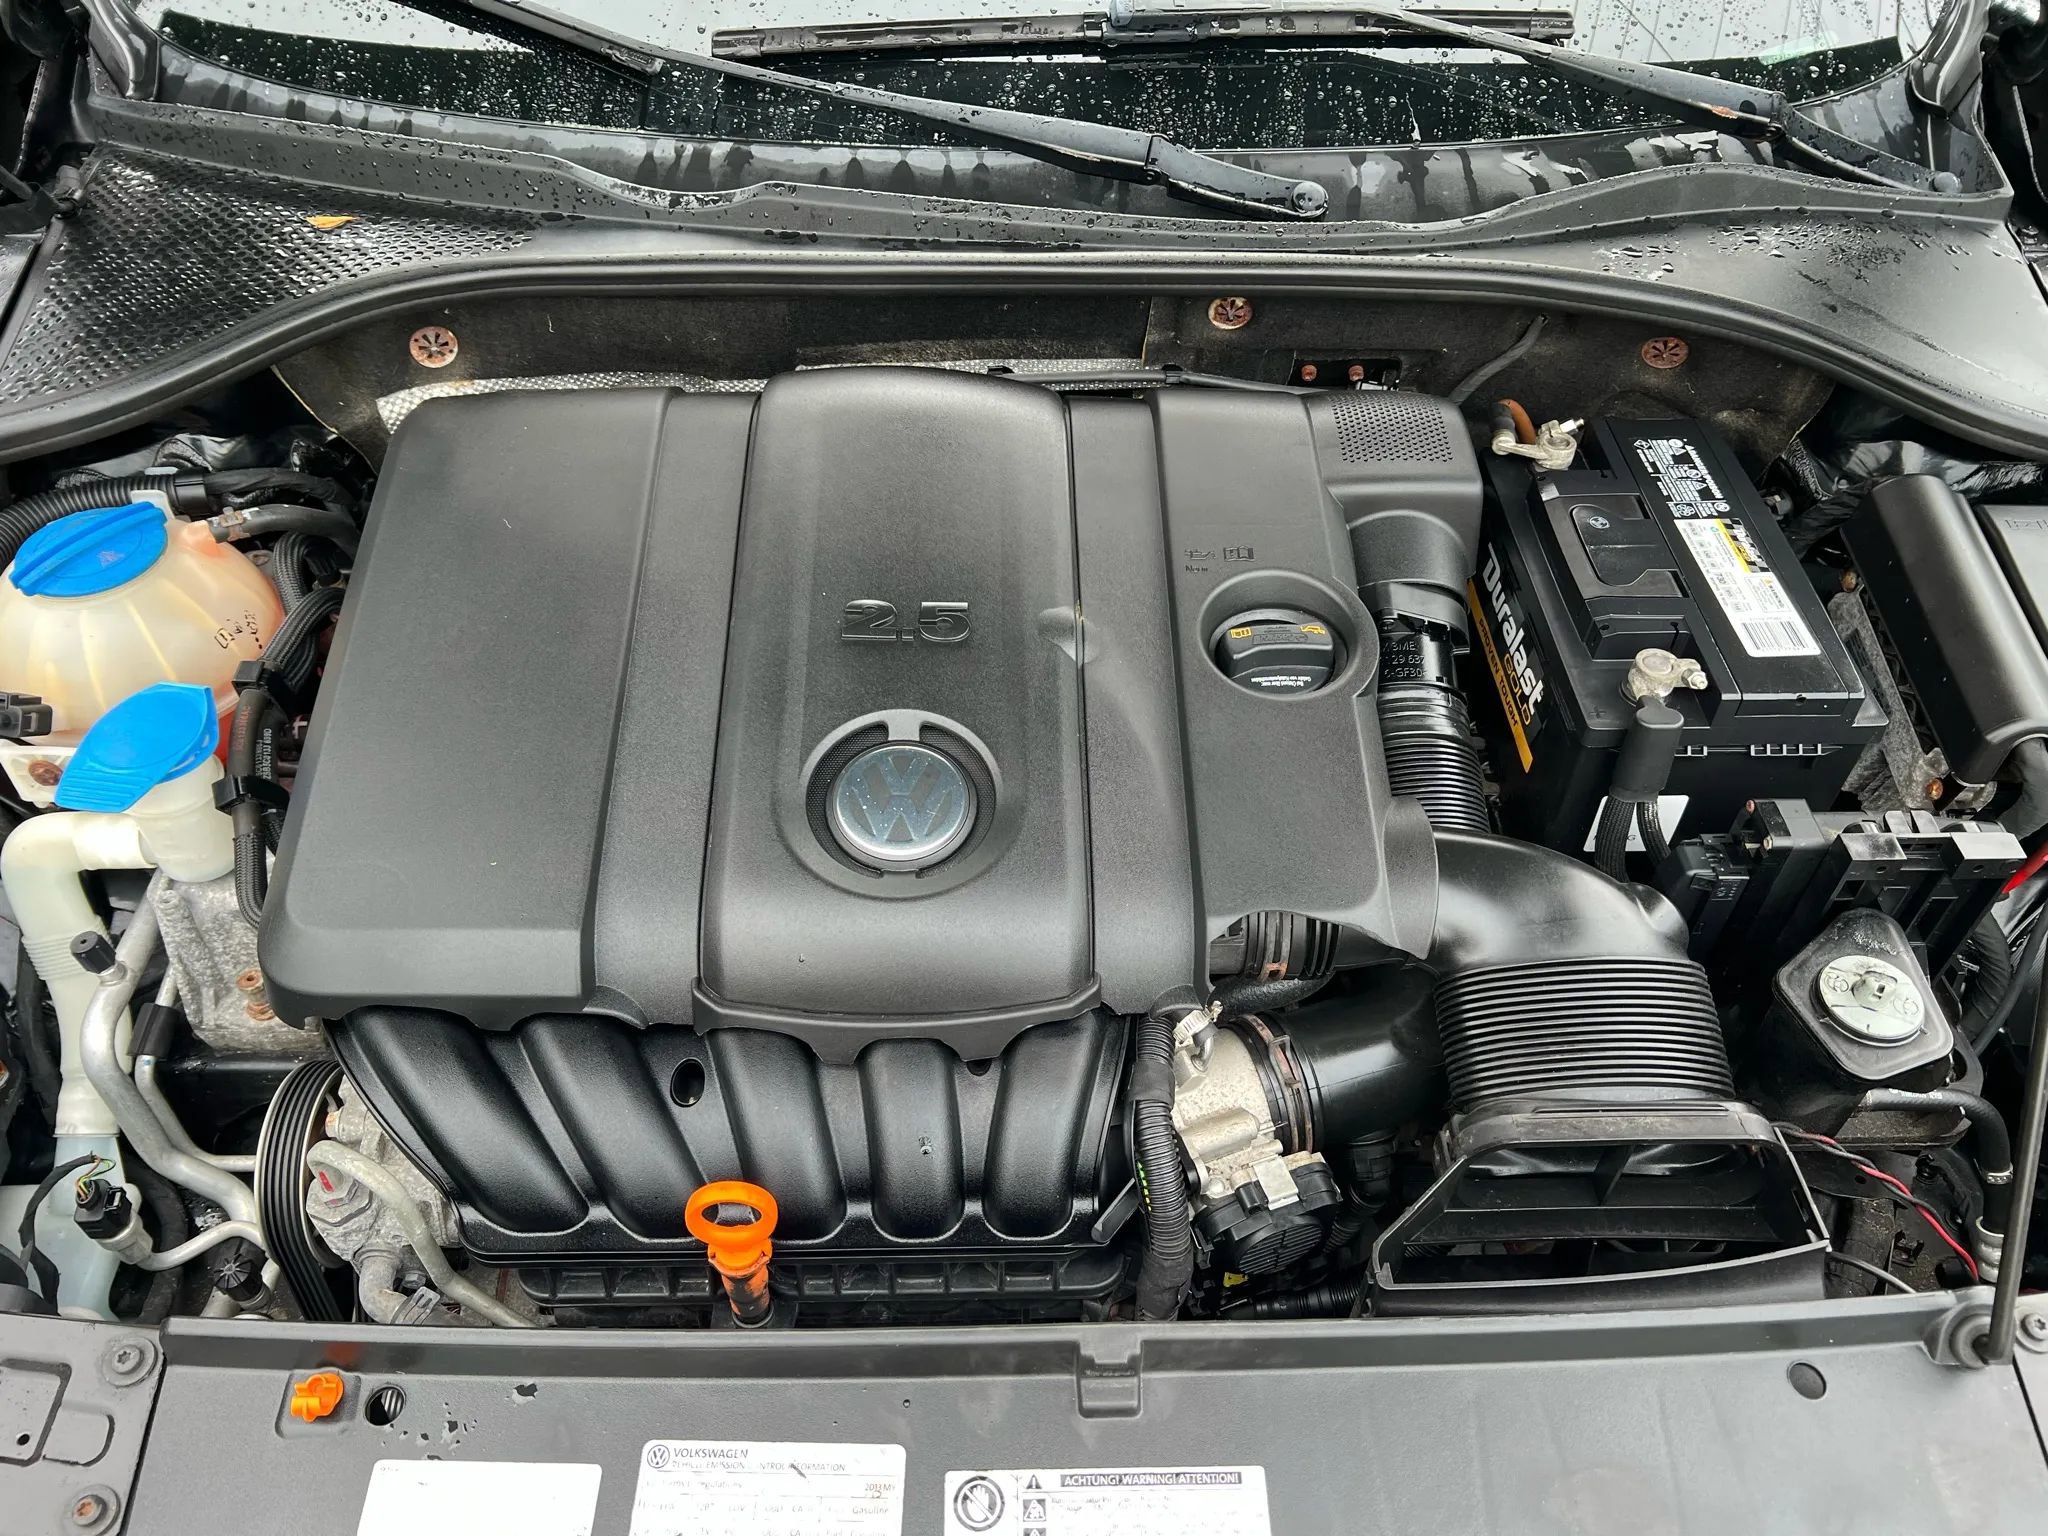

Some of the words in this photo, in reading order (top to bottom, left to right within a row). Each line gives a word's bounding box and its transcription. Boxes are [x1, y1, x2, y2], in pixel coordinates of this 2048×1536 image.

[841, 599, 972, 642] 2.5
[1482, 542, 1544, 716] Duralast
[1478, 618, 1500, 674] PROVEN
[1499, 678, 1518, 727] TOUGH
[1504, 653, 1531, 726] GOLD
[673, 1448, 749, 1459] VOLKSWAGEN
[1064, 1474, 1120, 1486] ACHTUNG!
[1122, 1473, 1177, 1485] WARNING!
[1178, 1472, 1239, 1484] ATTENTION!
[853, 1506, 889, 1515] Gasoline
